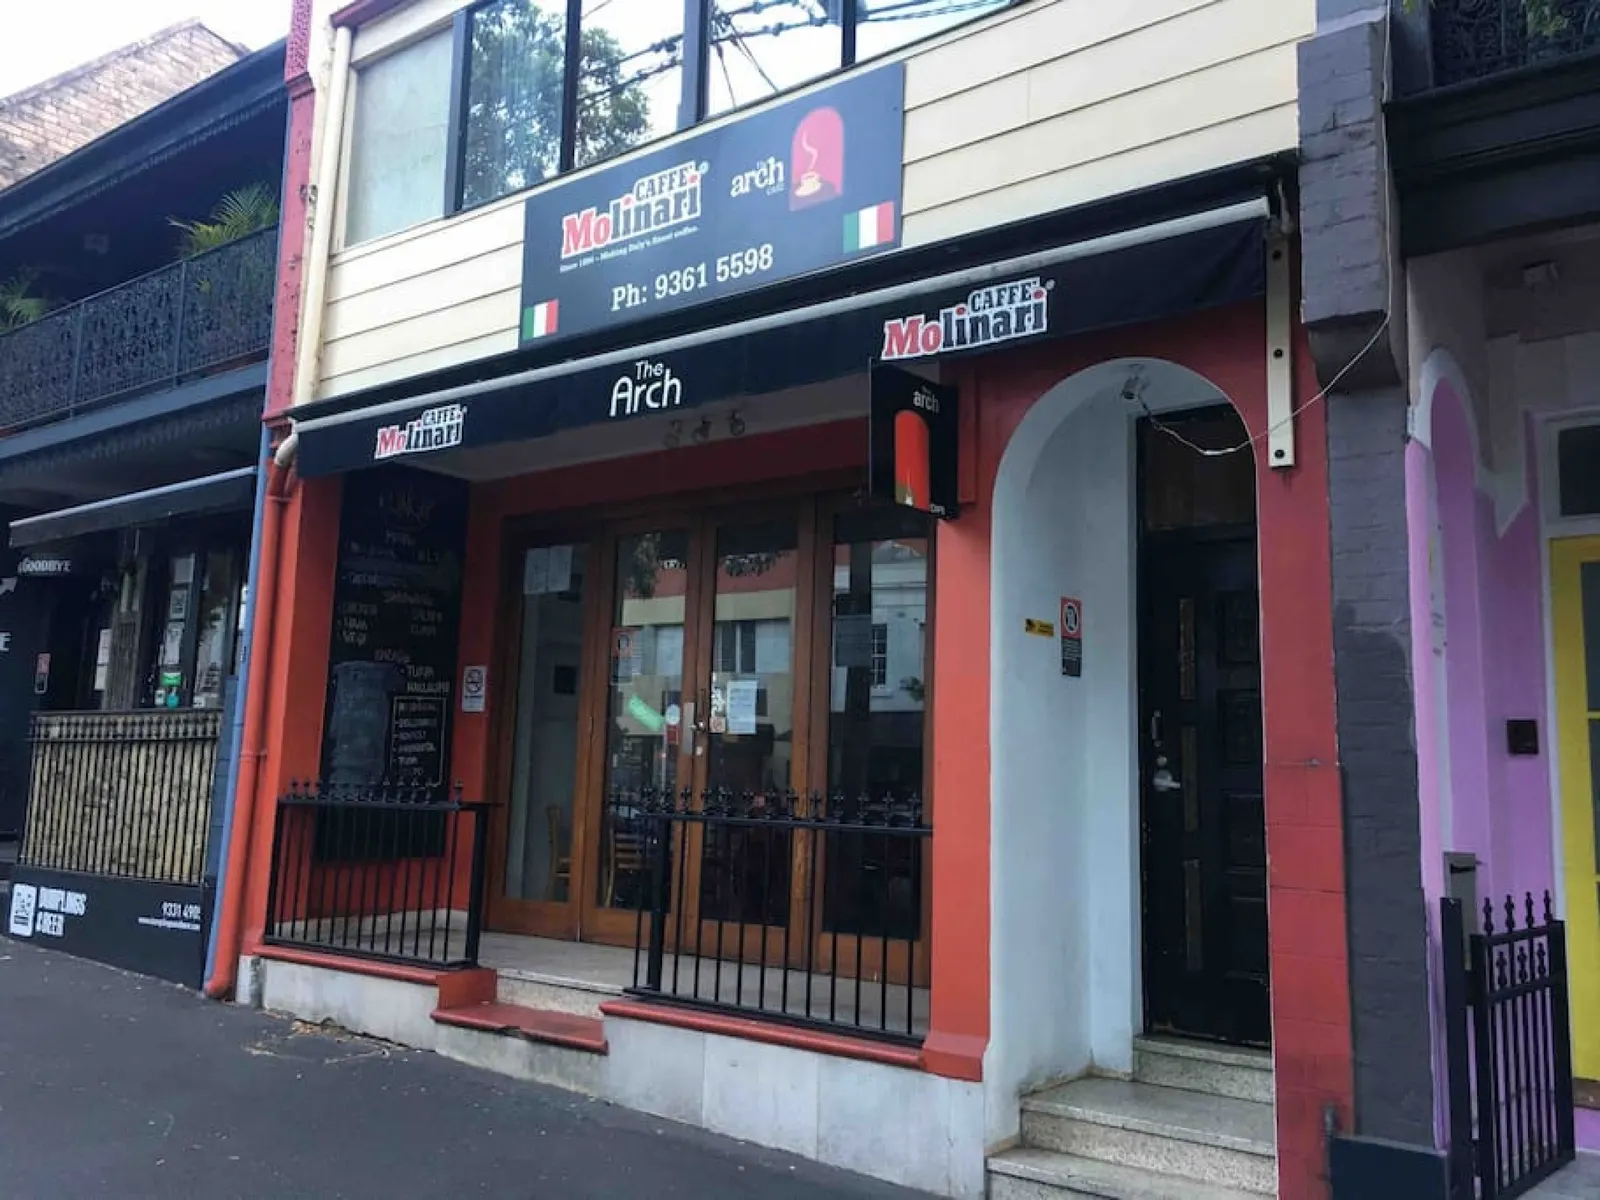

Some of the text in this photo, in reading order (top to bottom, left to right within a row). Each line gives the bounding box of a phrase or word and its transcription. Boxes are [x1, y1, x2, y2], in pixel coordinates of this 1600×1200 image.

[730, 156, 784, 197] arch
[562, 173, 701, 258] Molinari
[611, 243, 774, 311] Ph: 9361 5598
[883, 288, 1047, 359] Molinari
[609, 369, 681, 417] Arch
[635, 360, 664, 380] The
[912, 391, 940, 413] arch
[376, 411, 463, 458] Molinari
